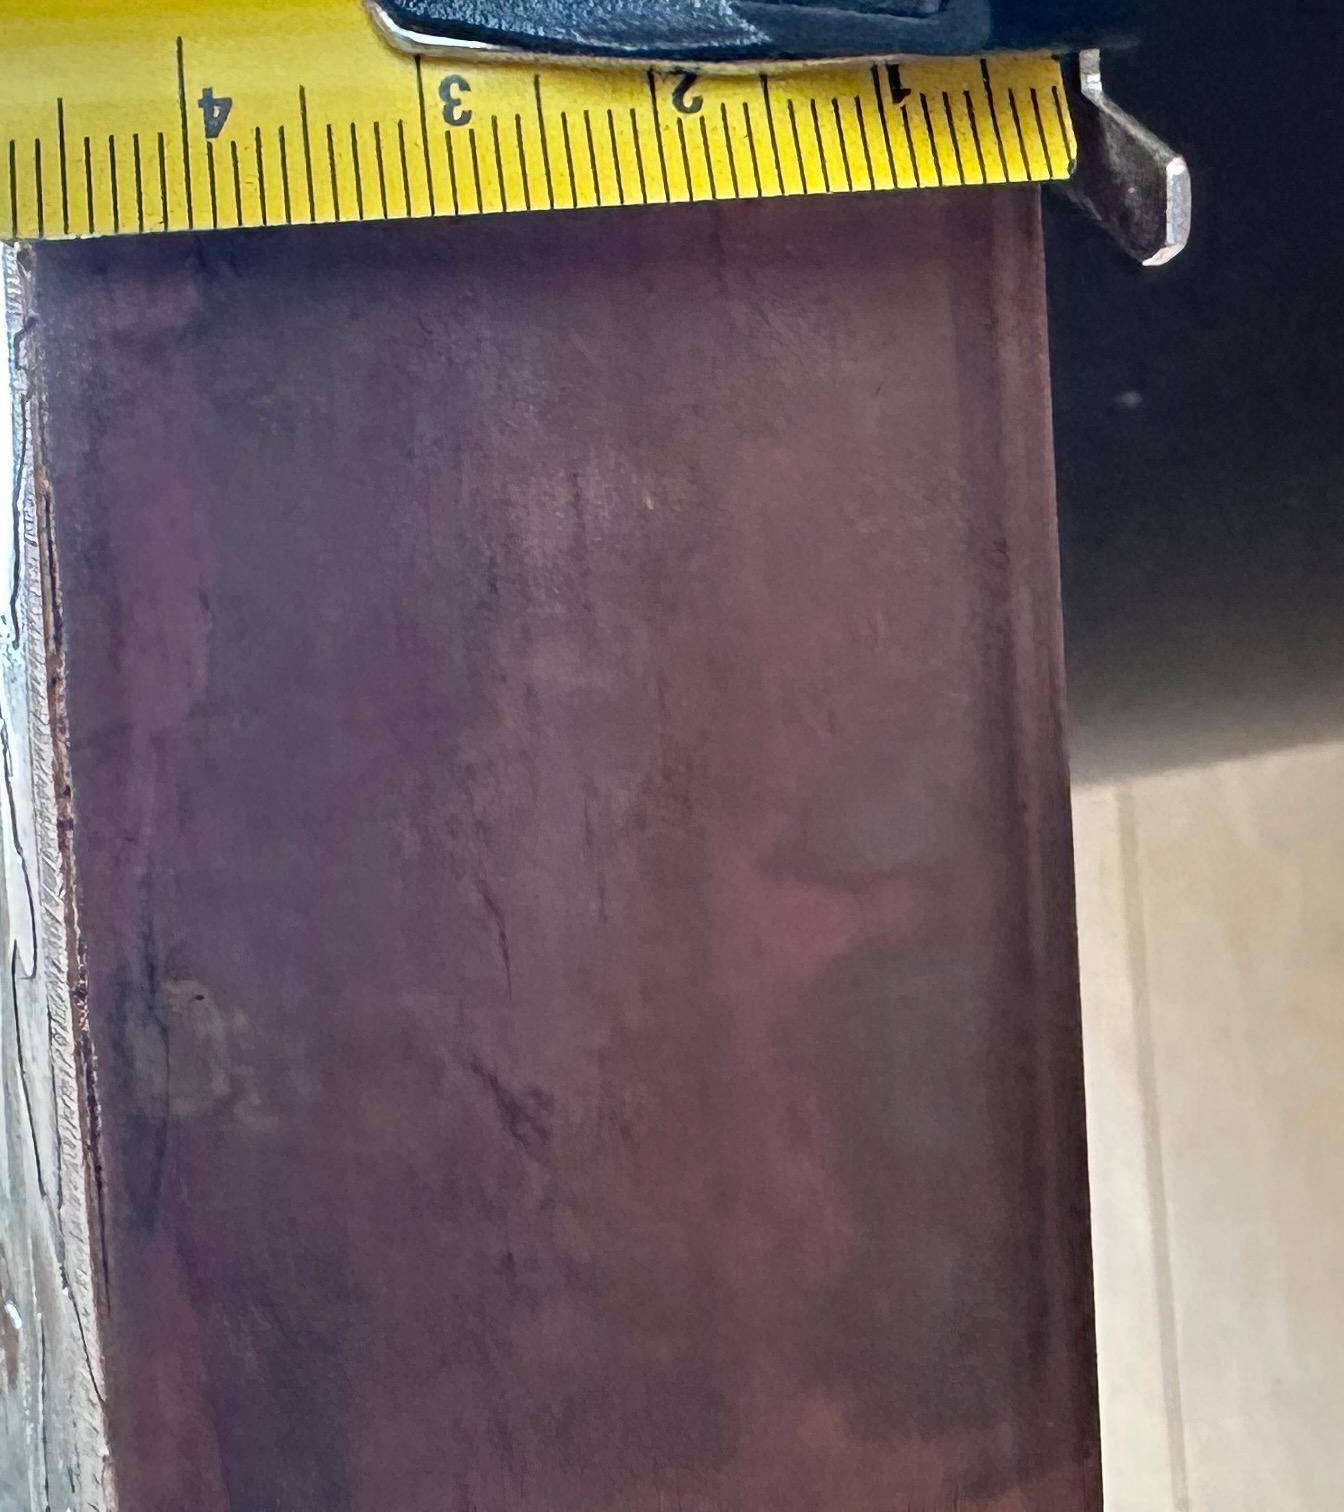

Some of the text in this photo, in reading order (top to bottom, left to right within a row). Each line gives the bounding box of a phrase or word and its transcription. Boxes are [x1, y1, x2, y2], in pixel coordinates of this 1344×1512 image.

[438, 75, 472, 126] 3
[671, 70, 704, 114] 2
[885, 62, 913, 105] 1
[197, 87, 233, 139] 4
